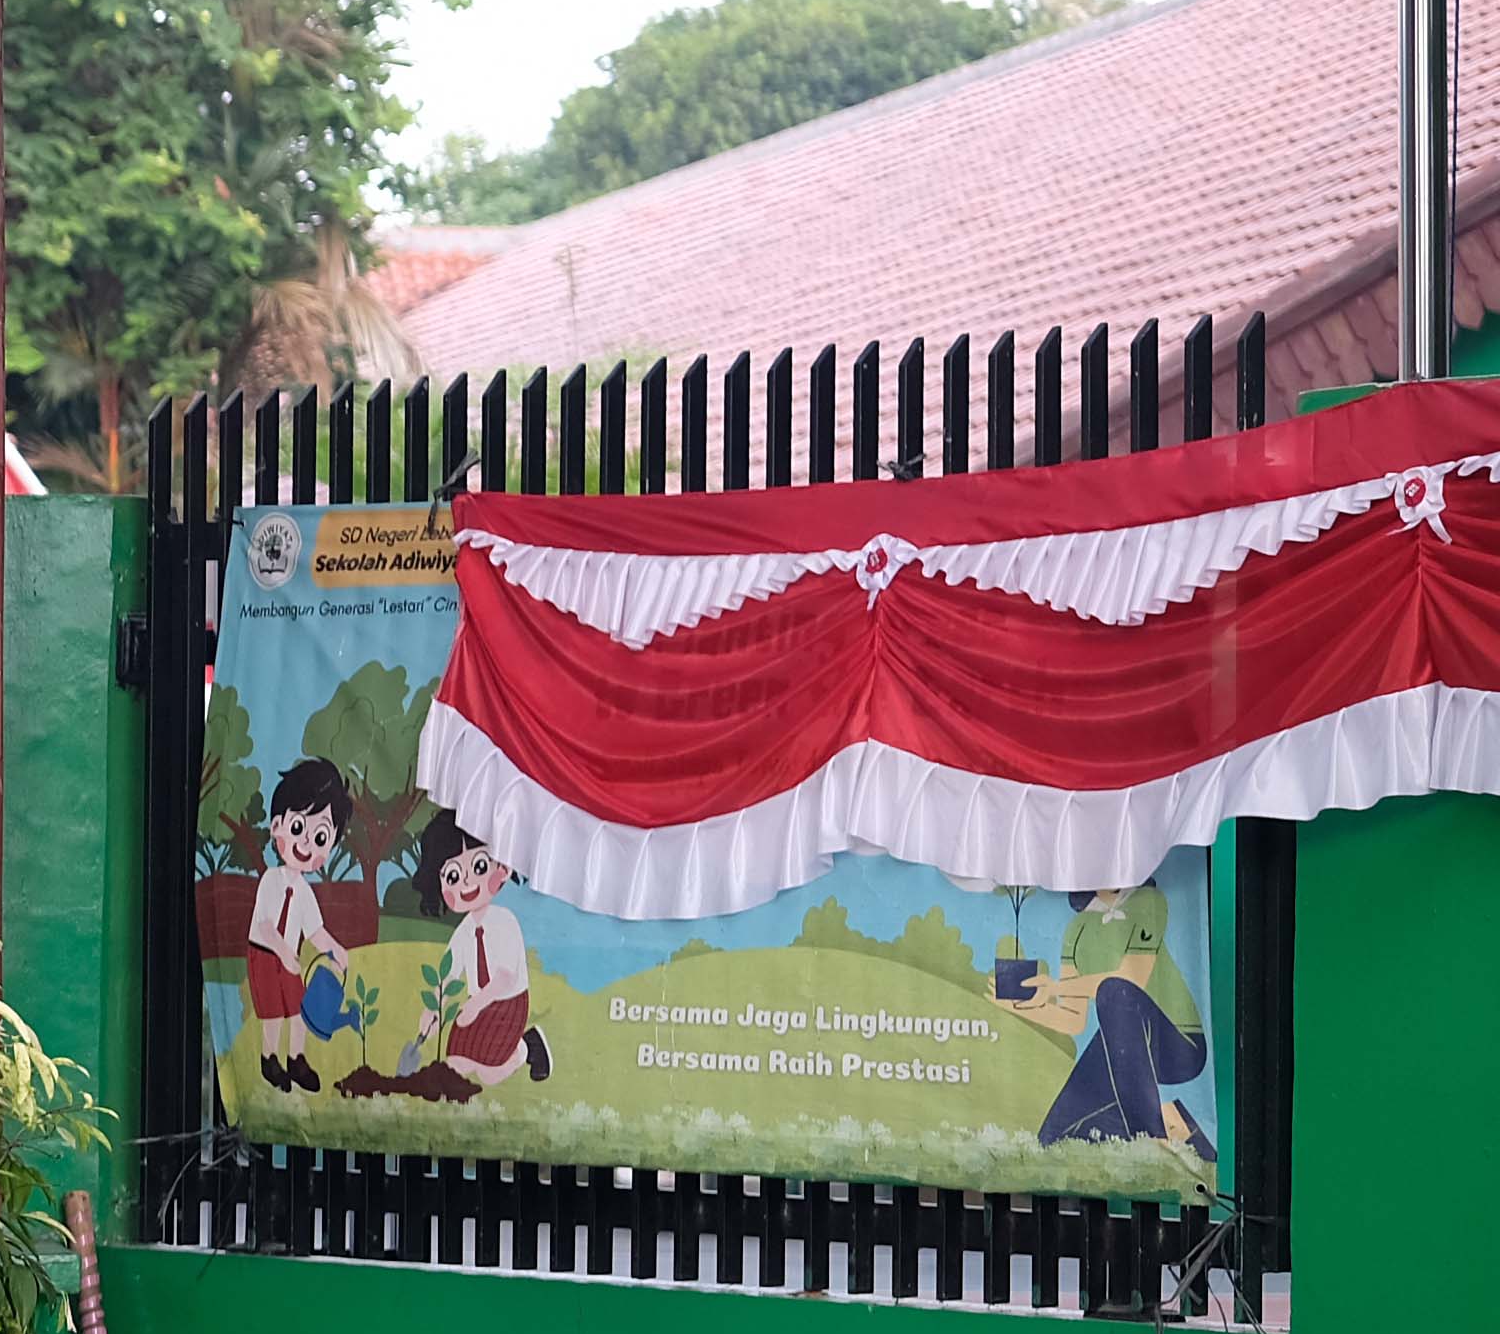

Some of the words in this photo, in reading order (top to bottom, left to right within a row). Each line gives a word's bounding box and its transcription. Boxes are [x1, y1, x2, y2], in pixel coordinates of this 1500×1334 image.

[340, 526, 363, 544] SD
[366, 525, 419, 547] Negeri
[315, 551, 388, 573] Sekolah
[240, 599, 314, 621] Membangun
[319, 599, 375, 617] Generasi
[609, 997, 729, 1026] Bersama
[737, 1003, 807, 1035] Jaga
[816, 1006, 999, 1042] Lingkungan,
[637, 1043, 760, 1073] Bersama
[768, 1049, 833, 1076] Raih
[841, 1053, 971, 1084] Prestasi
